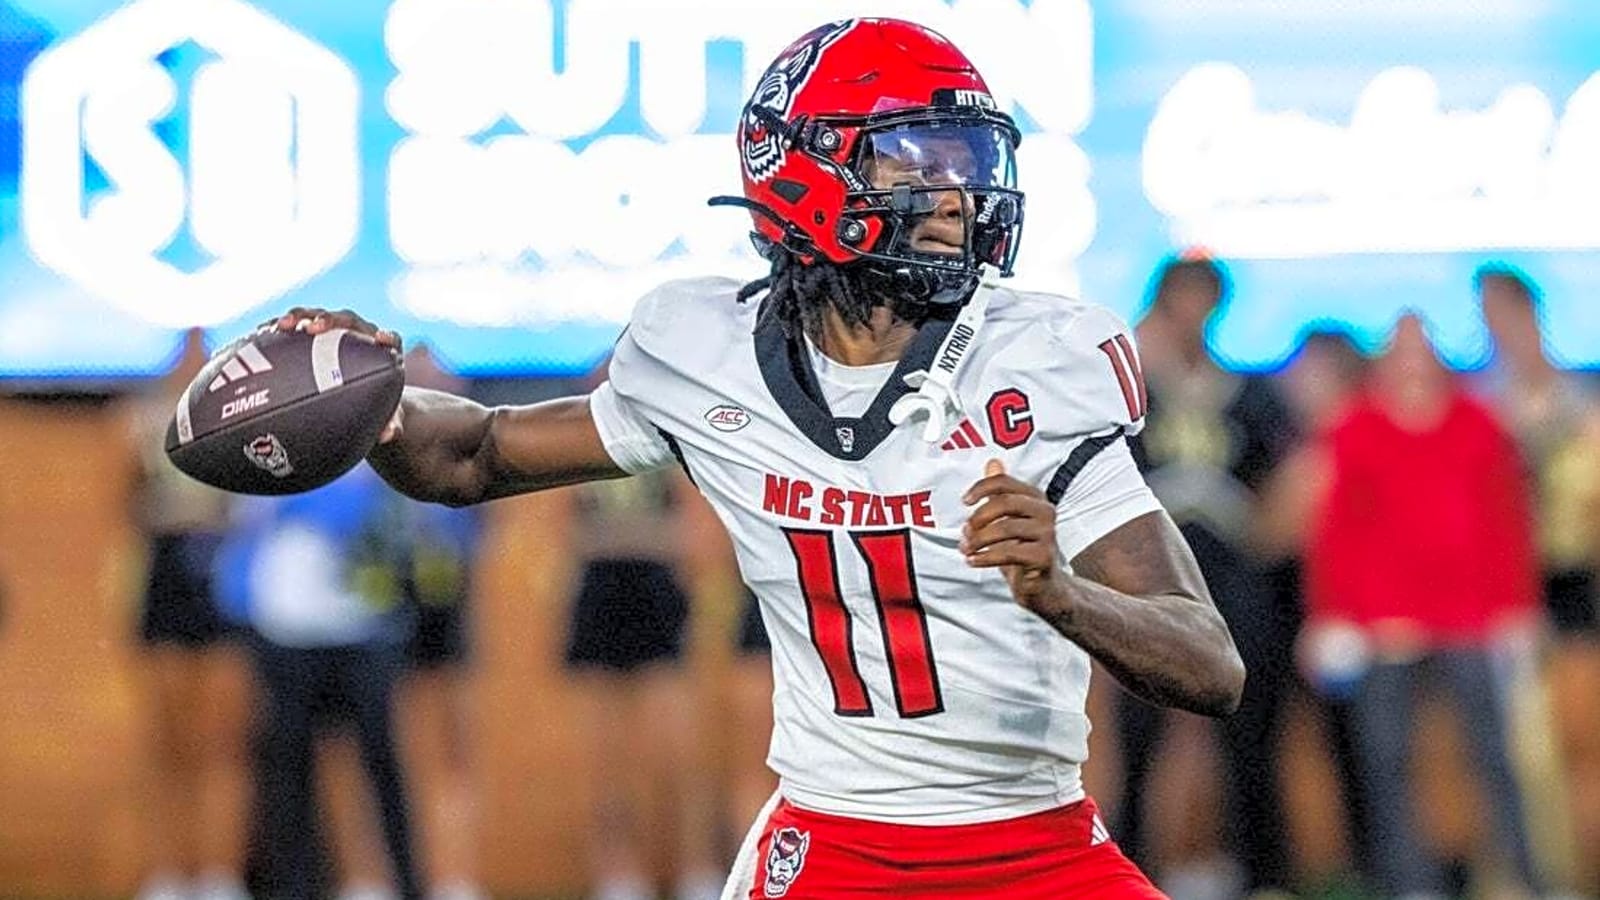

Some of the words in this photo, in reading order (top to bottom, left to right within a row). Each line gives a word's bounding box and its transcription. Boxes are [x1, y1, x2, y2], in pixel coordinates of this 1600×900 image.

[937, 323, 975, 374] NXTRND
[221, 388, 269, 420] DIME
[1097, 333, 1148, 422] 11
[711, 411, 744, 424] ACC
[985, 387, 1035, 450] C
[763, 473, 814, 521] NC
[820, 487, 936, 528] STATE
[779, 526, 945, 719] 11
